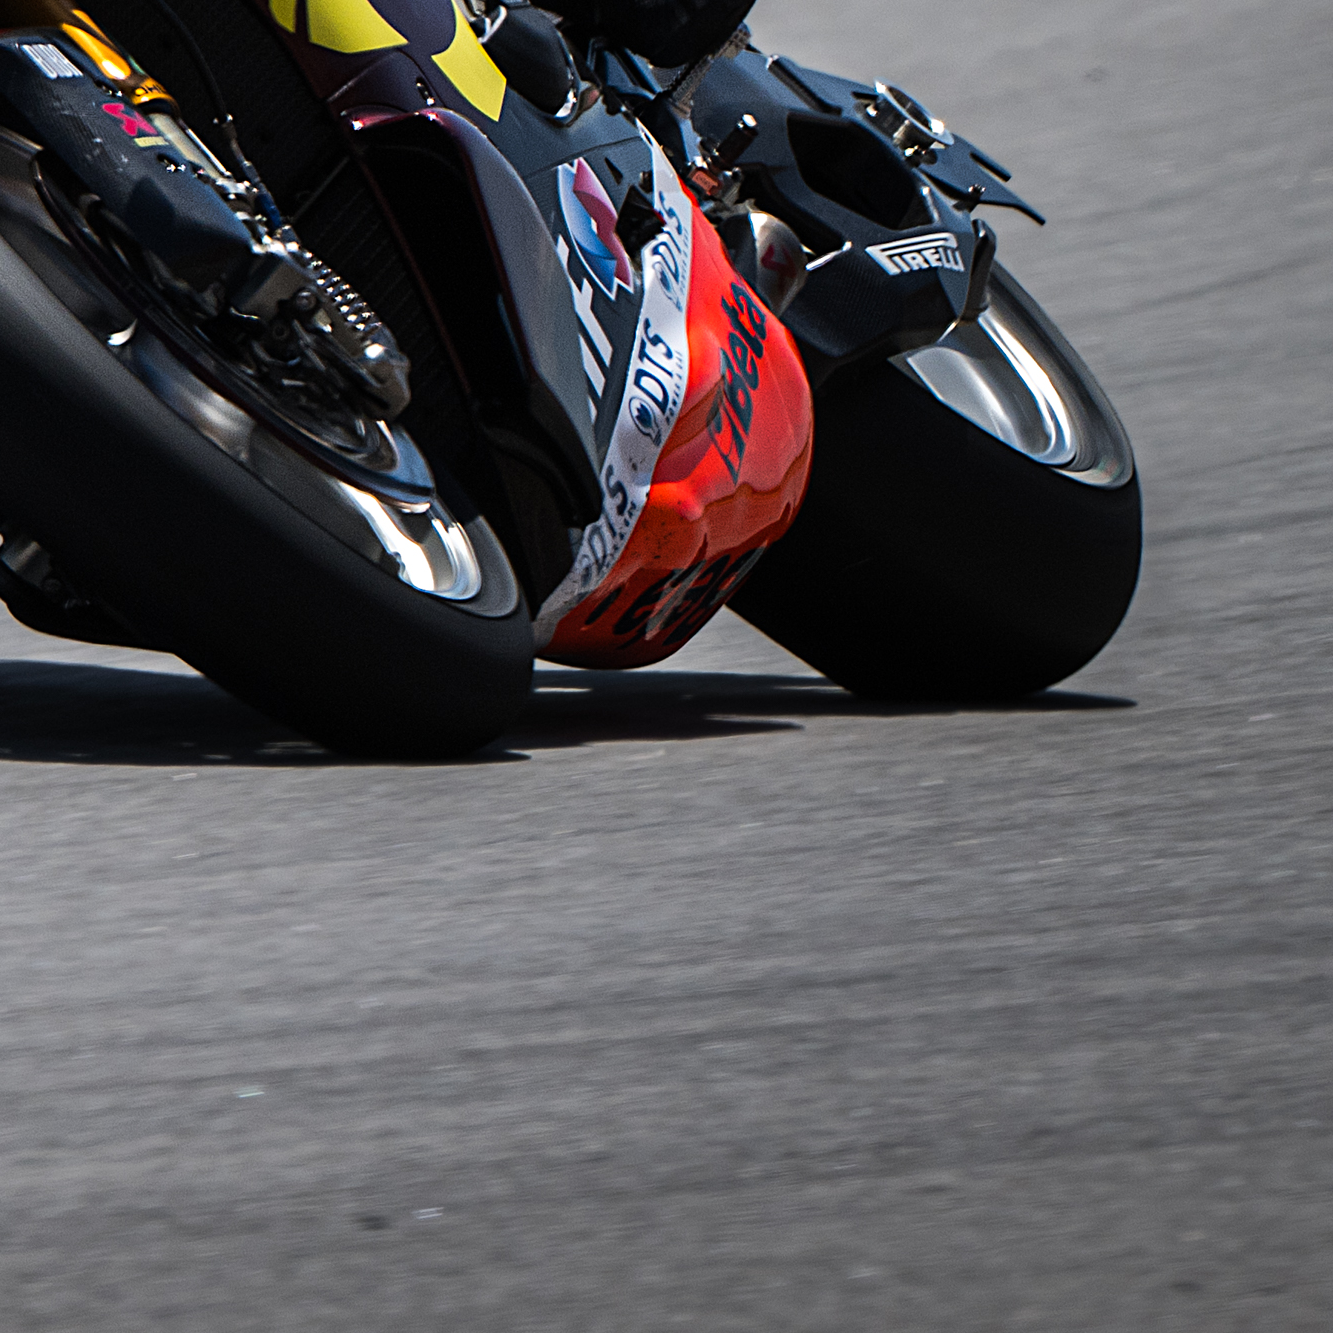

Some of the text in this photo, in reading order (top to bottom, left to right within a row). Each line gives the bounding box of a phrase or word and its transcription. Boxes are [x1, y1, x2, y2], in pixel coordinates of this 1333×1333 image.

[865, 232, 965, 276] PIRELLI
[634, 318, 674, 414] DTS
[720, 281, 767, 437] Beta
